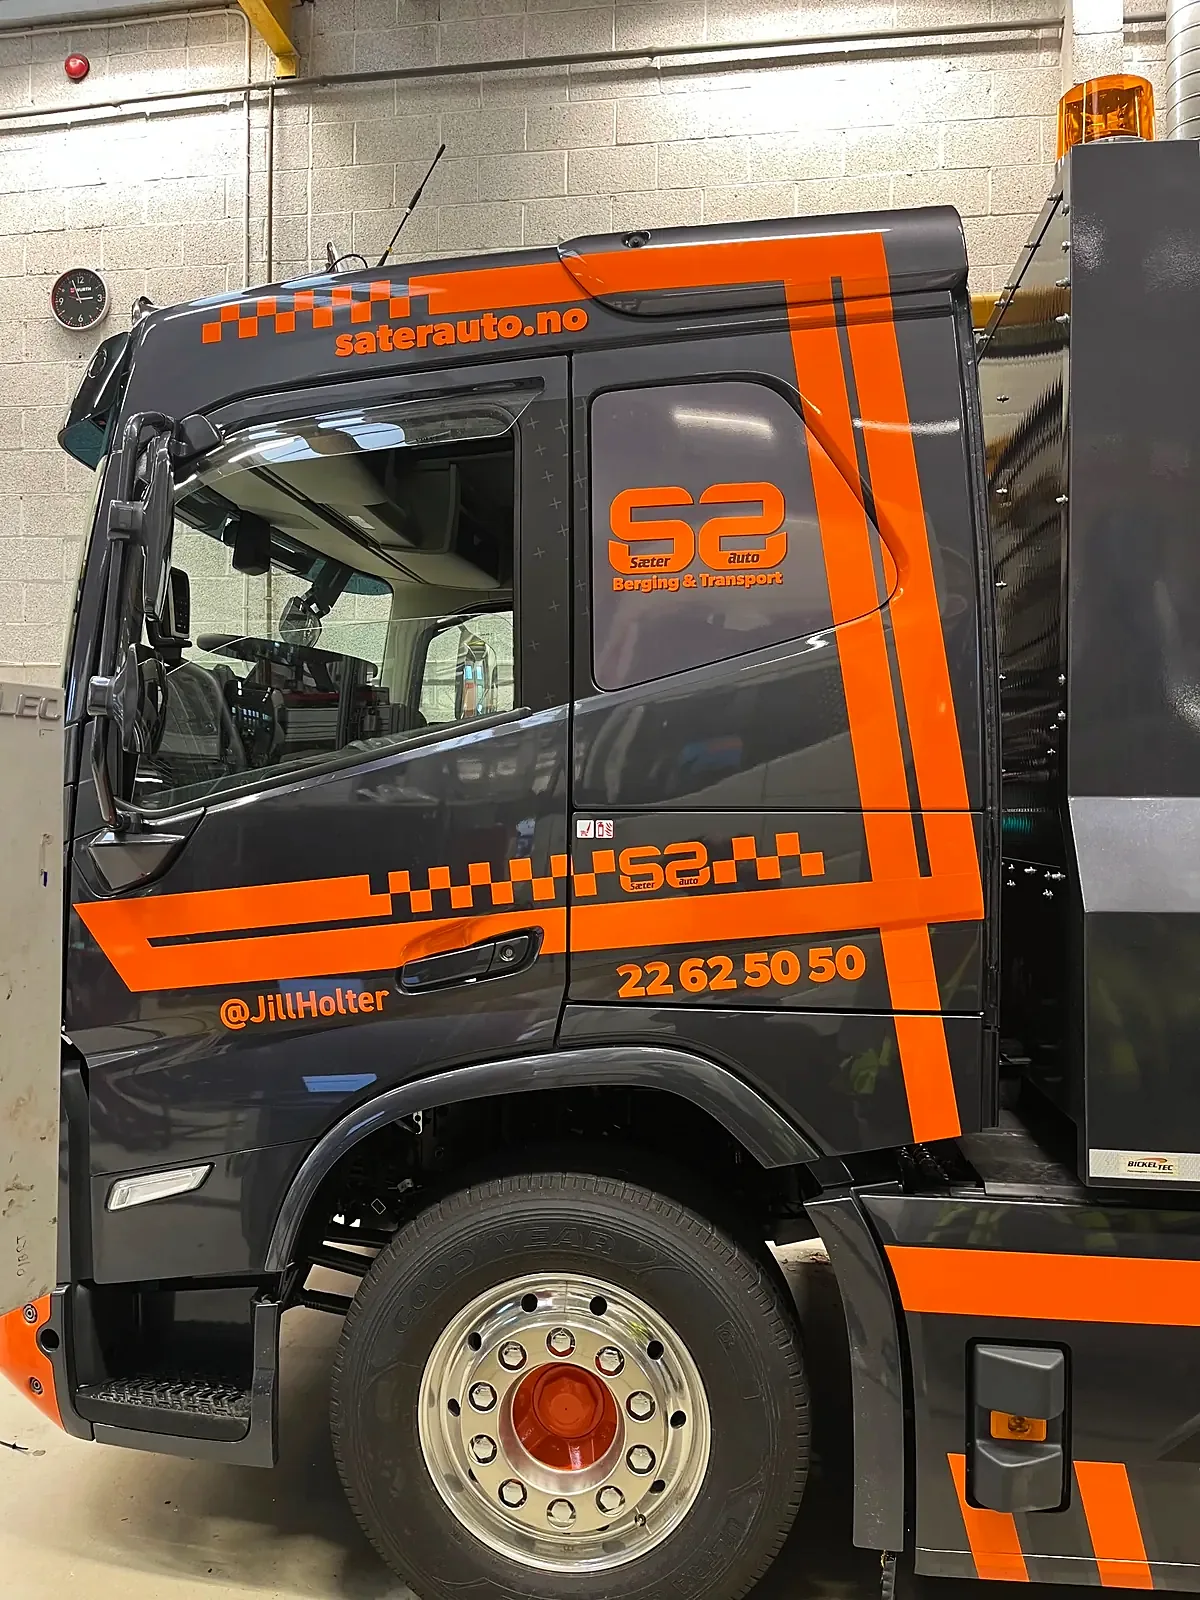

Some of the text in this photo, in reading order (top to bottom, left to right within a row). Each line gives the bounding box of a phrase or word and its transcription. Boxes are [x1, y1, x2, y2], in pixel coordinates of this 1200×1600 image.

[58, 297, 64, 306] 9
[97, 293, 103, 302] 3
[78, 314, 83, 322] 6
[334, 307, 589, 357] saterauto.no
[630, 552, 760, 569] Sæter auto
[612, 571, 784, 593] Berging & Transport
[678, 877, 699, 886] auto
[615, 945, 866, 998] 22 62 50 50
[219, 987, 390, 1031] @JillHolter
